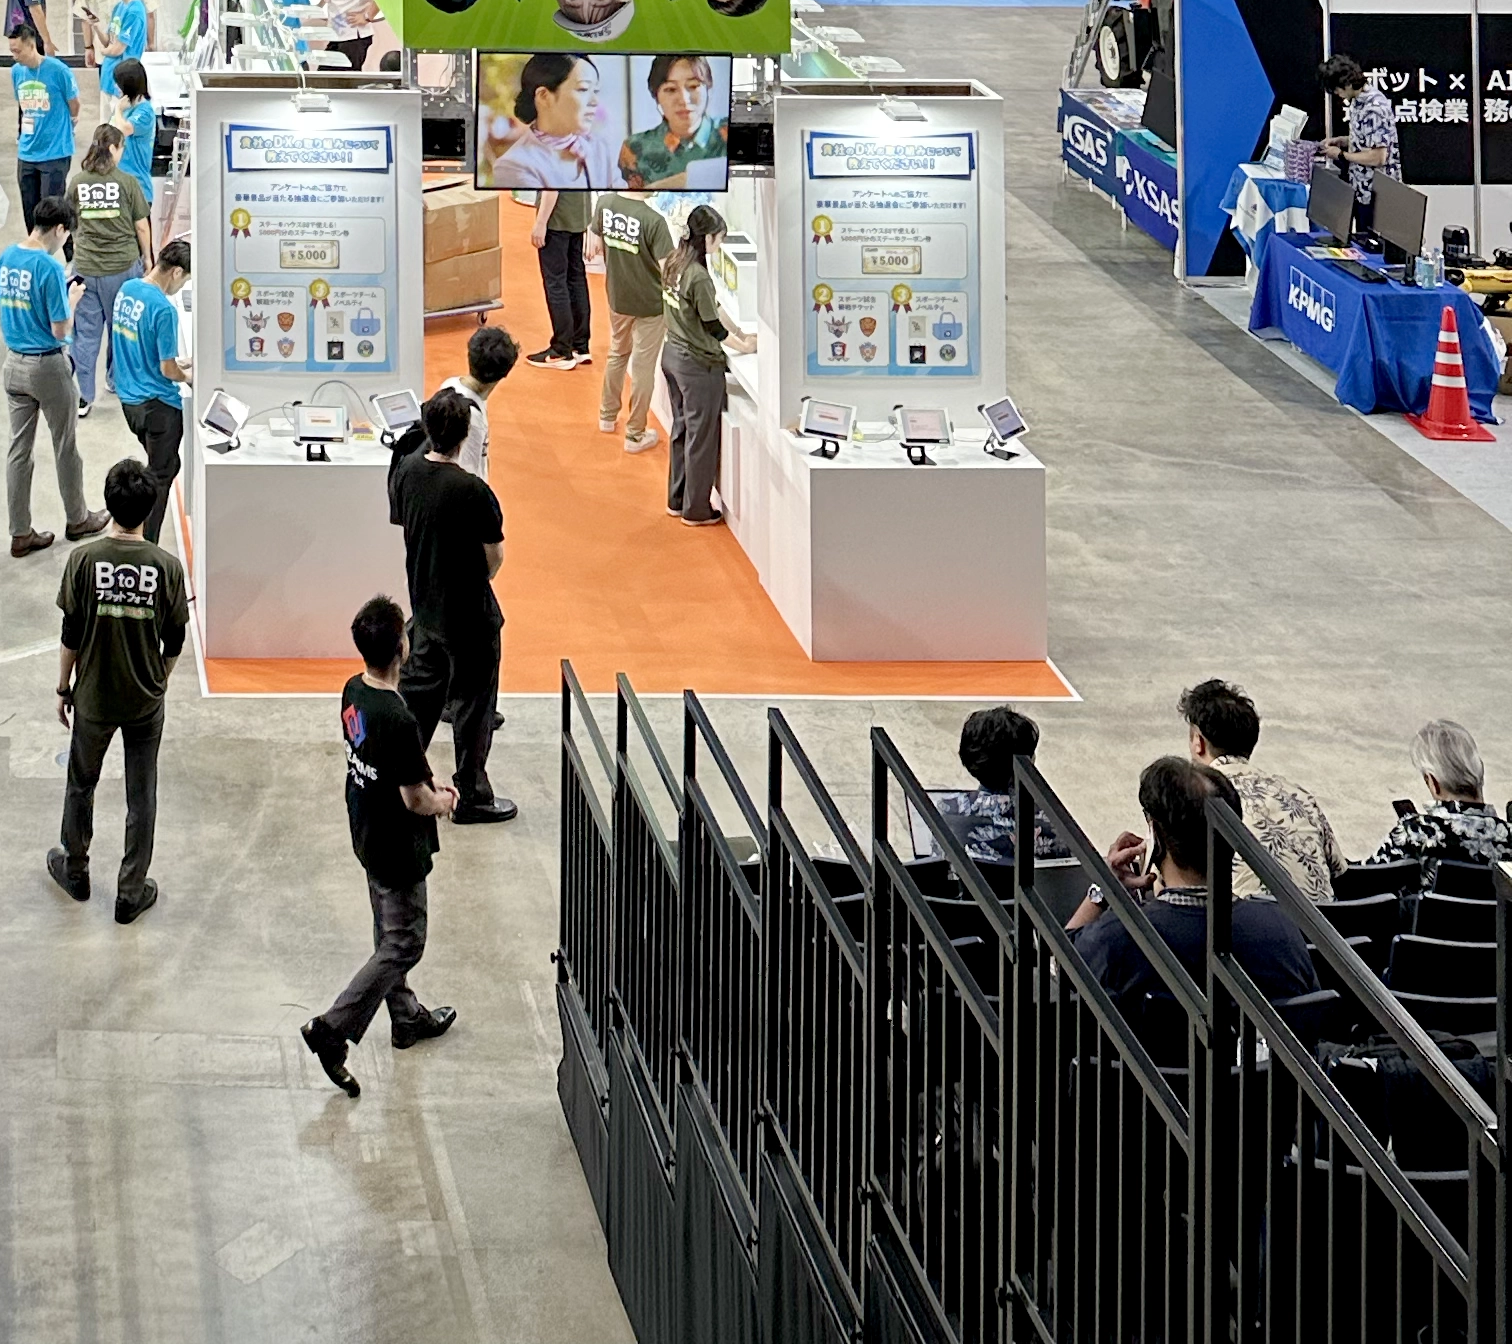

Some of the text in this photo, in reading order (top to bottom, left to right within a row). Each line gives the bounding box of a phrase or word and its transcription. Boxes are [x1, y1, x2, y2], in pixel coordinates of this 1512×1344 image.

[1062, 115, 1109, 167] KSAS
[77, 182, 120, 202] BtoB
[1133, 168, 1179, 231] KSAS
[1288, 284, 1335, 333] KPMG
[94, 561, 159, 595] BtoB
[95, 589, 155, 606] プラットフォーム
